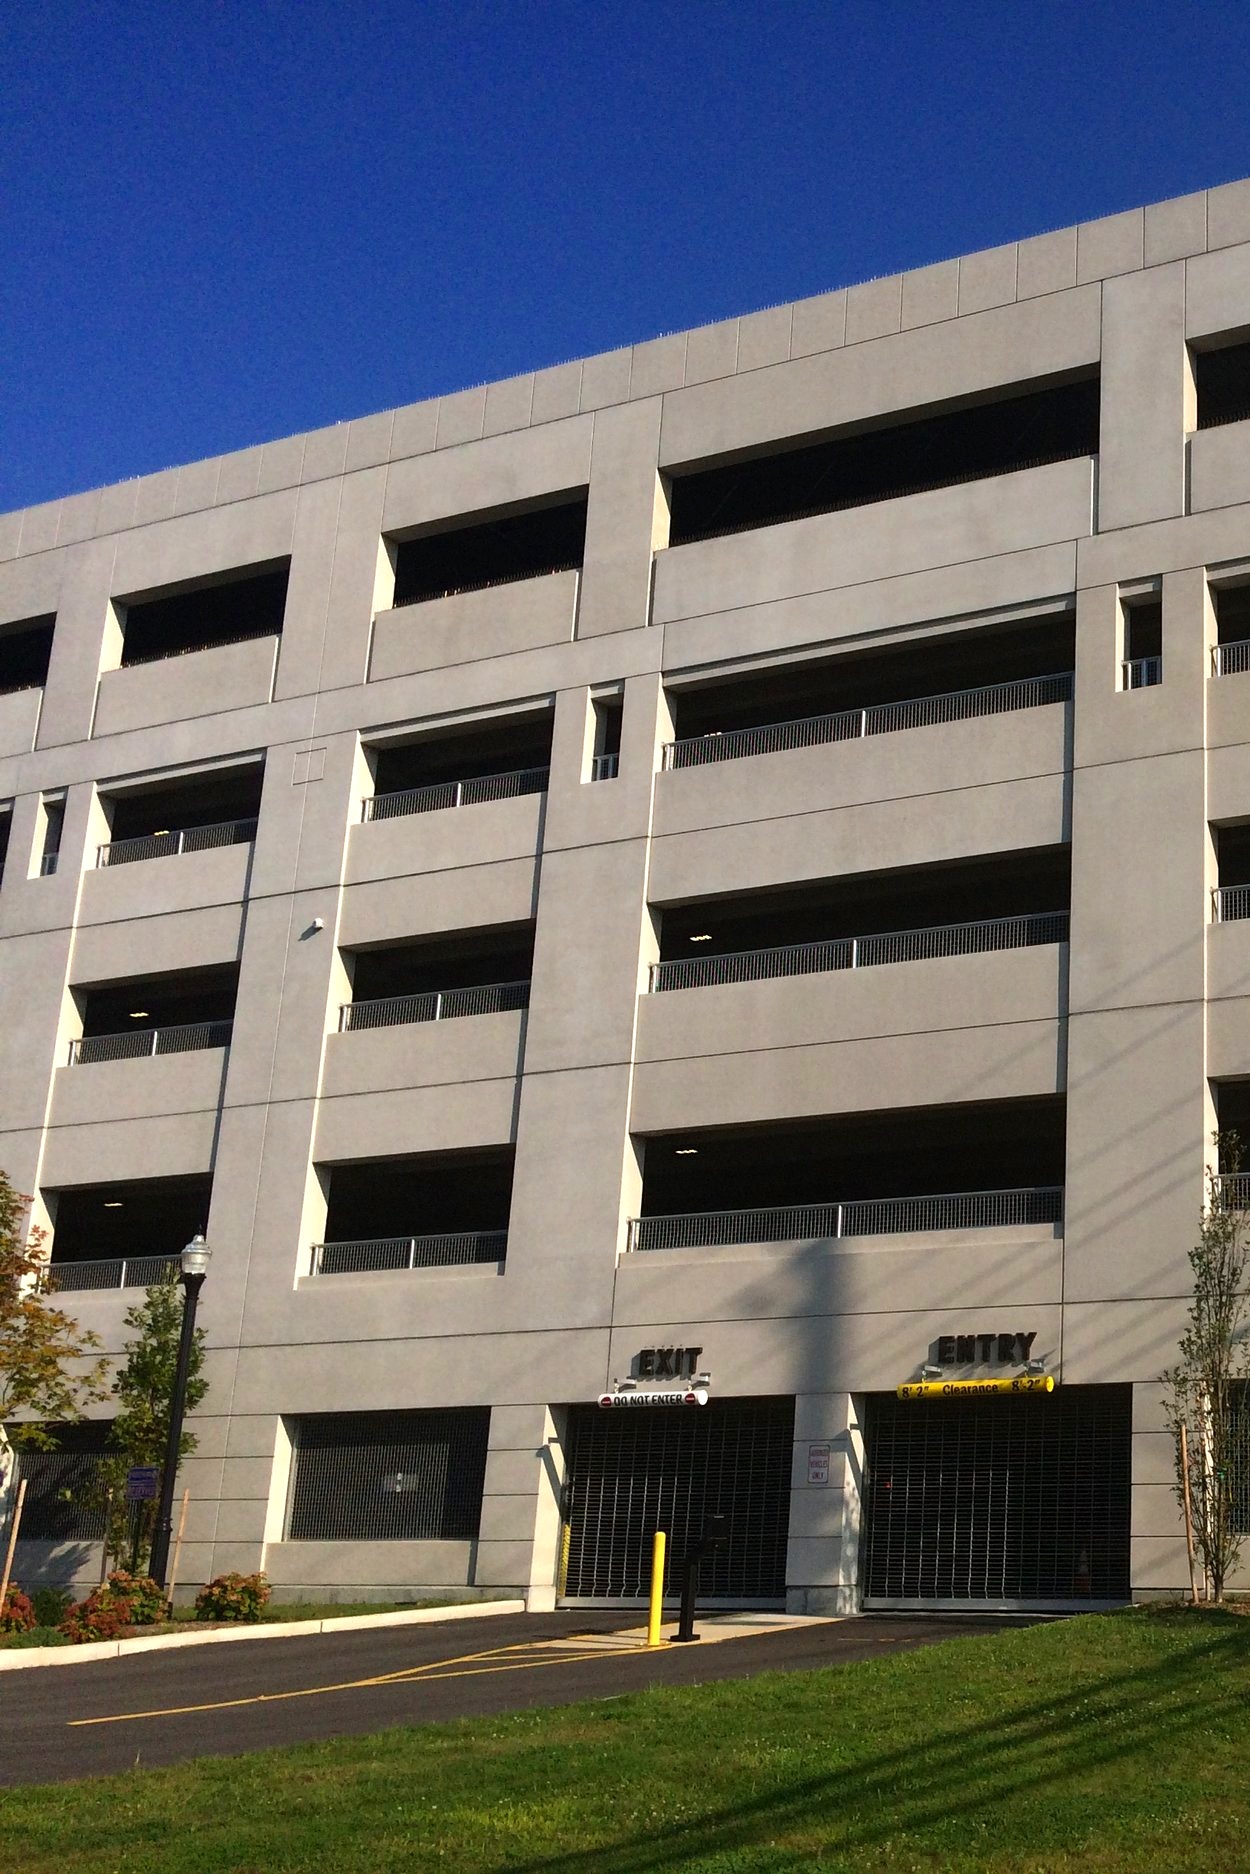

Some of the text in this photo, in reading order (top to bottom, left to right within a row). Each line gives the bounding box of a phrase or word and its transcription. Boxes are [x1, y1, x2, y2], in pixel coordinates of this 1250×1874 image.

[938, 1332, 1037, 1363] ENTRY
[639, 1347, 703, 1376] EXIT
[943, 1384, 998, 1395] Clearance
[613, 1394, 683, 1406] DO NOT ENTER
